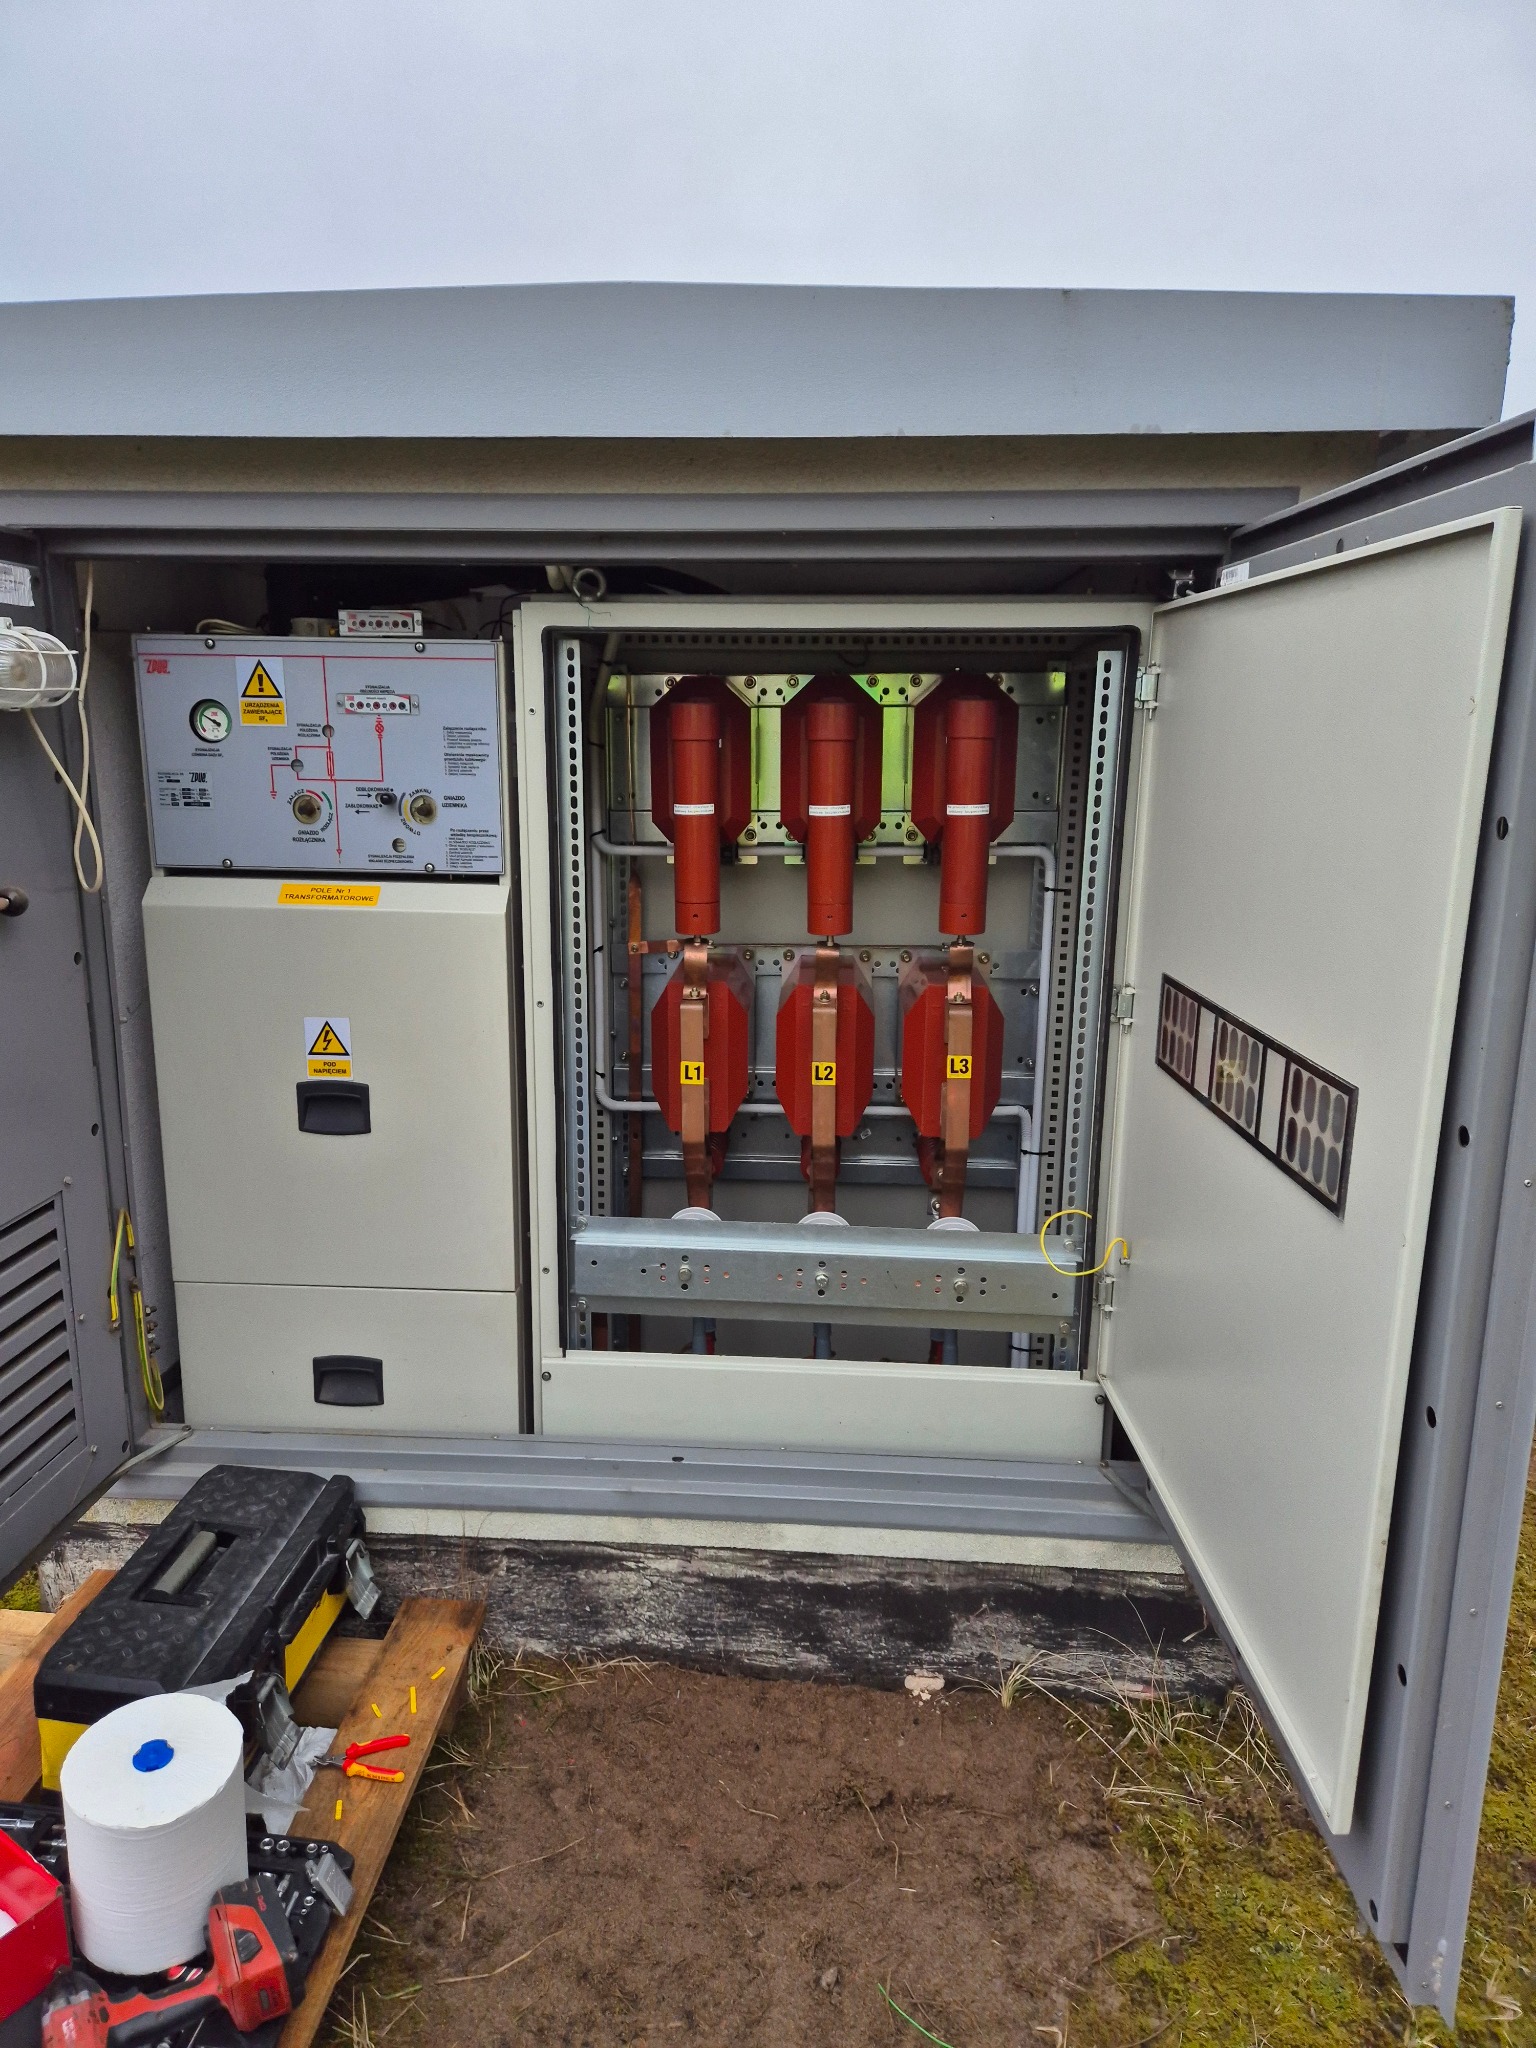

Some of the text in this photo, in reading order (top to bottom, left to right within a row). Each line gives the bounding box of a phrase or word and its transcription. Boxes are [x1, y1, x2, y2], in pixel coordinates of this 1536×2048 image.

[409, 788, 432, 798] ZAMKNIJ
[284, 893, 374, 902] TRANSFORMATOROWE
[684, 1066, 701, 1080] L1
[815, 1066, 834, 1081] L2
[950, 1059, 969, 1074] L3
